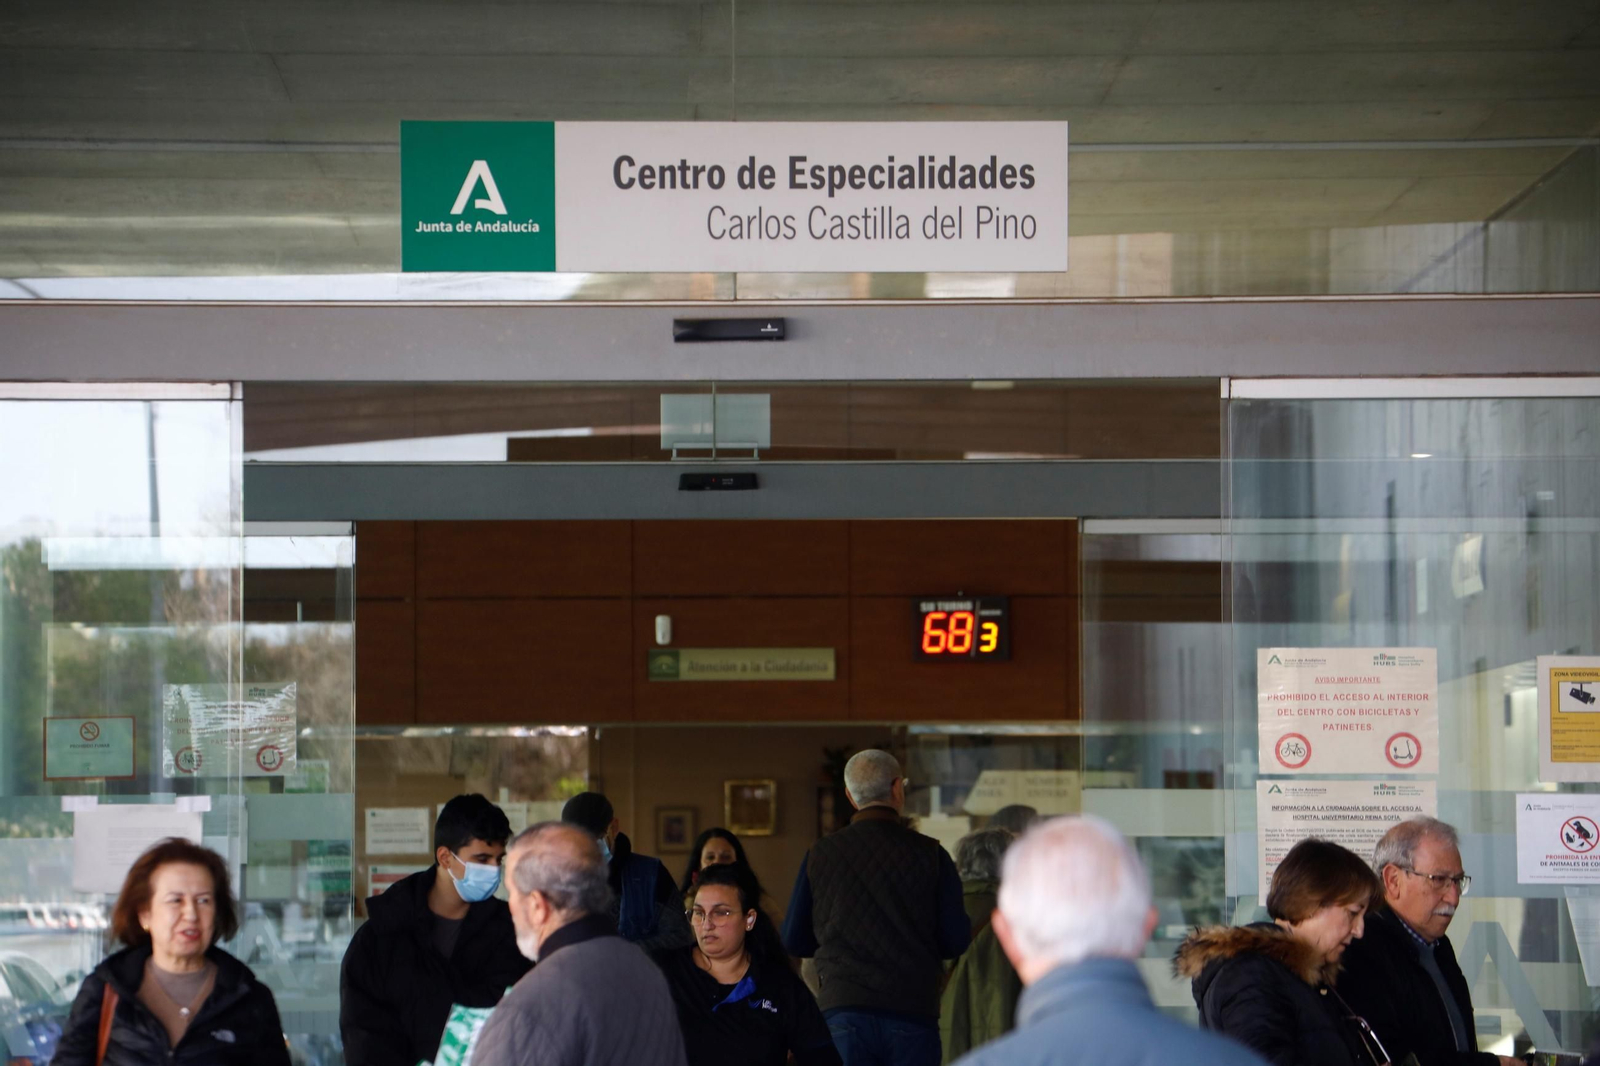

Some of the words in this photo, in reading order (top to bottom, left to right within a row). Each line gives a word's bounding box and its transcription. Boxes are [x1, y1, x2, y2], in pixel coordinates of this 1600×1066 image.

[613, 154, 726, 190] Centro
[737, 154, 776, 190] de
[788, 154, 1036, 197] Especialidades
[415, 219, 452, 234] Junta
[456, 219, 472, 234] de
[475, 217, 540, 234] Andalucía
[706, 205, 797, 241] Carlos
[807, 205, 911, 241] Castilla
[921, 205, 963, 241] del
[976, 205, 1038, 241] Pino
[921, 611, 975, 655] 68
[979, 622, 999, 653] 3
[687, 659, 738, 673] Atención
[740, 662, 748, 673] a
[750, 659, 761, 673] la
[764, 658, 828, 673] Ciudadanía
[1315, 676, 1335, 684] AVISO
[1337, 676, 1381, 684] IMPORTANTE
[1570, 670, 1600, 678] VIDEOVIGIL
[1267, 693, 1317, 702] PROHIBIDO
[1319, 693, 1331, 701] EL
[1333, 693, 1371, 701] ACCESO
[1373, 693, 1385, 701] AL
[1387, 693, 1430, 701] INTERIOR
[1277, 708, 1295, 717] DEL
[1297, 708, 1334, 717] CENTRO
[1336, 708, 1356, 716] CON
[1358, 708, 1411, 716] BICICLETAS
[1413, 708, 1420, 716] Y
[1322, 723, 1375, 732] PATINETES.
[1271, 804, 1312, 812] INFORMACIÓN
[1325, 804, 1361, 812] CIUDADANÍA
